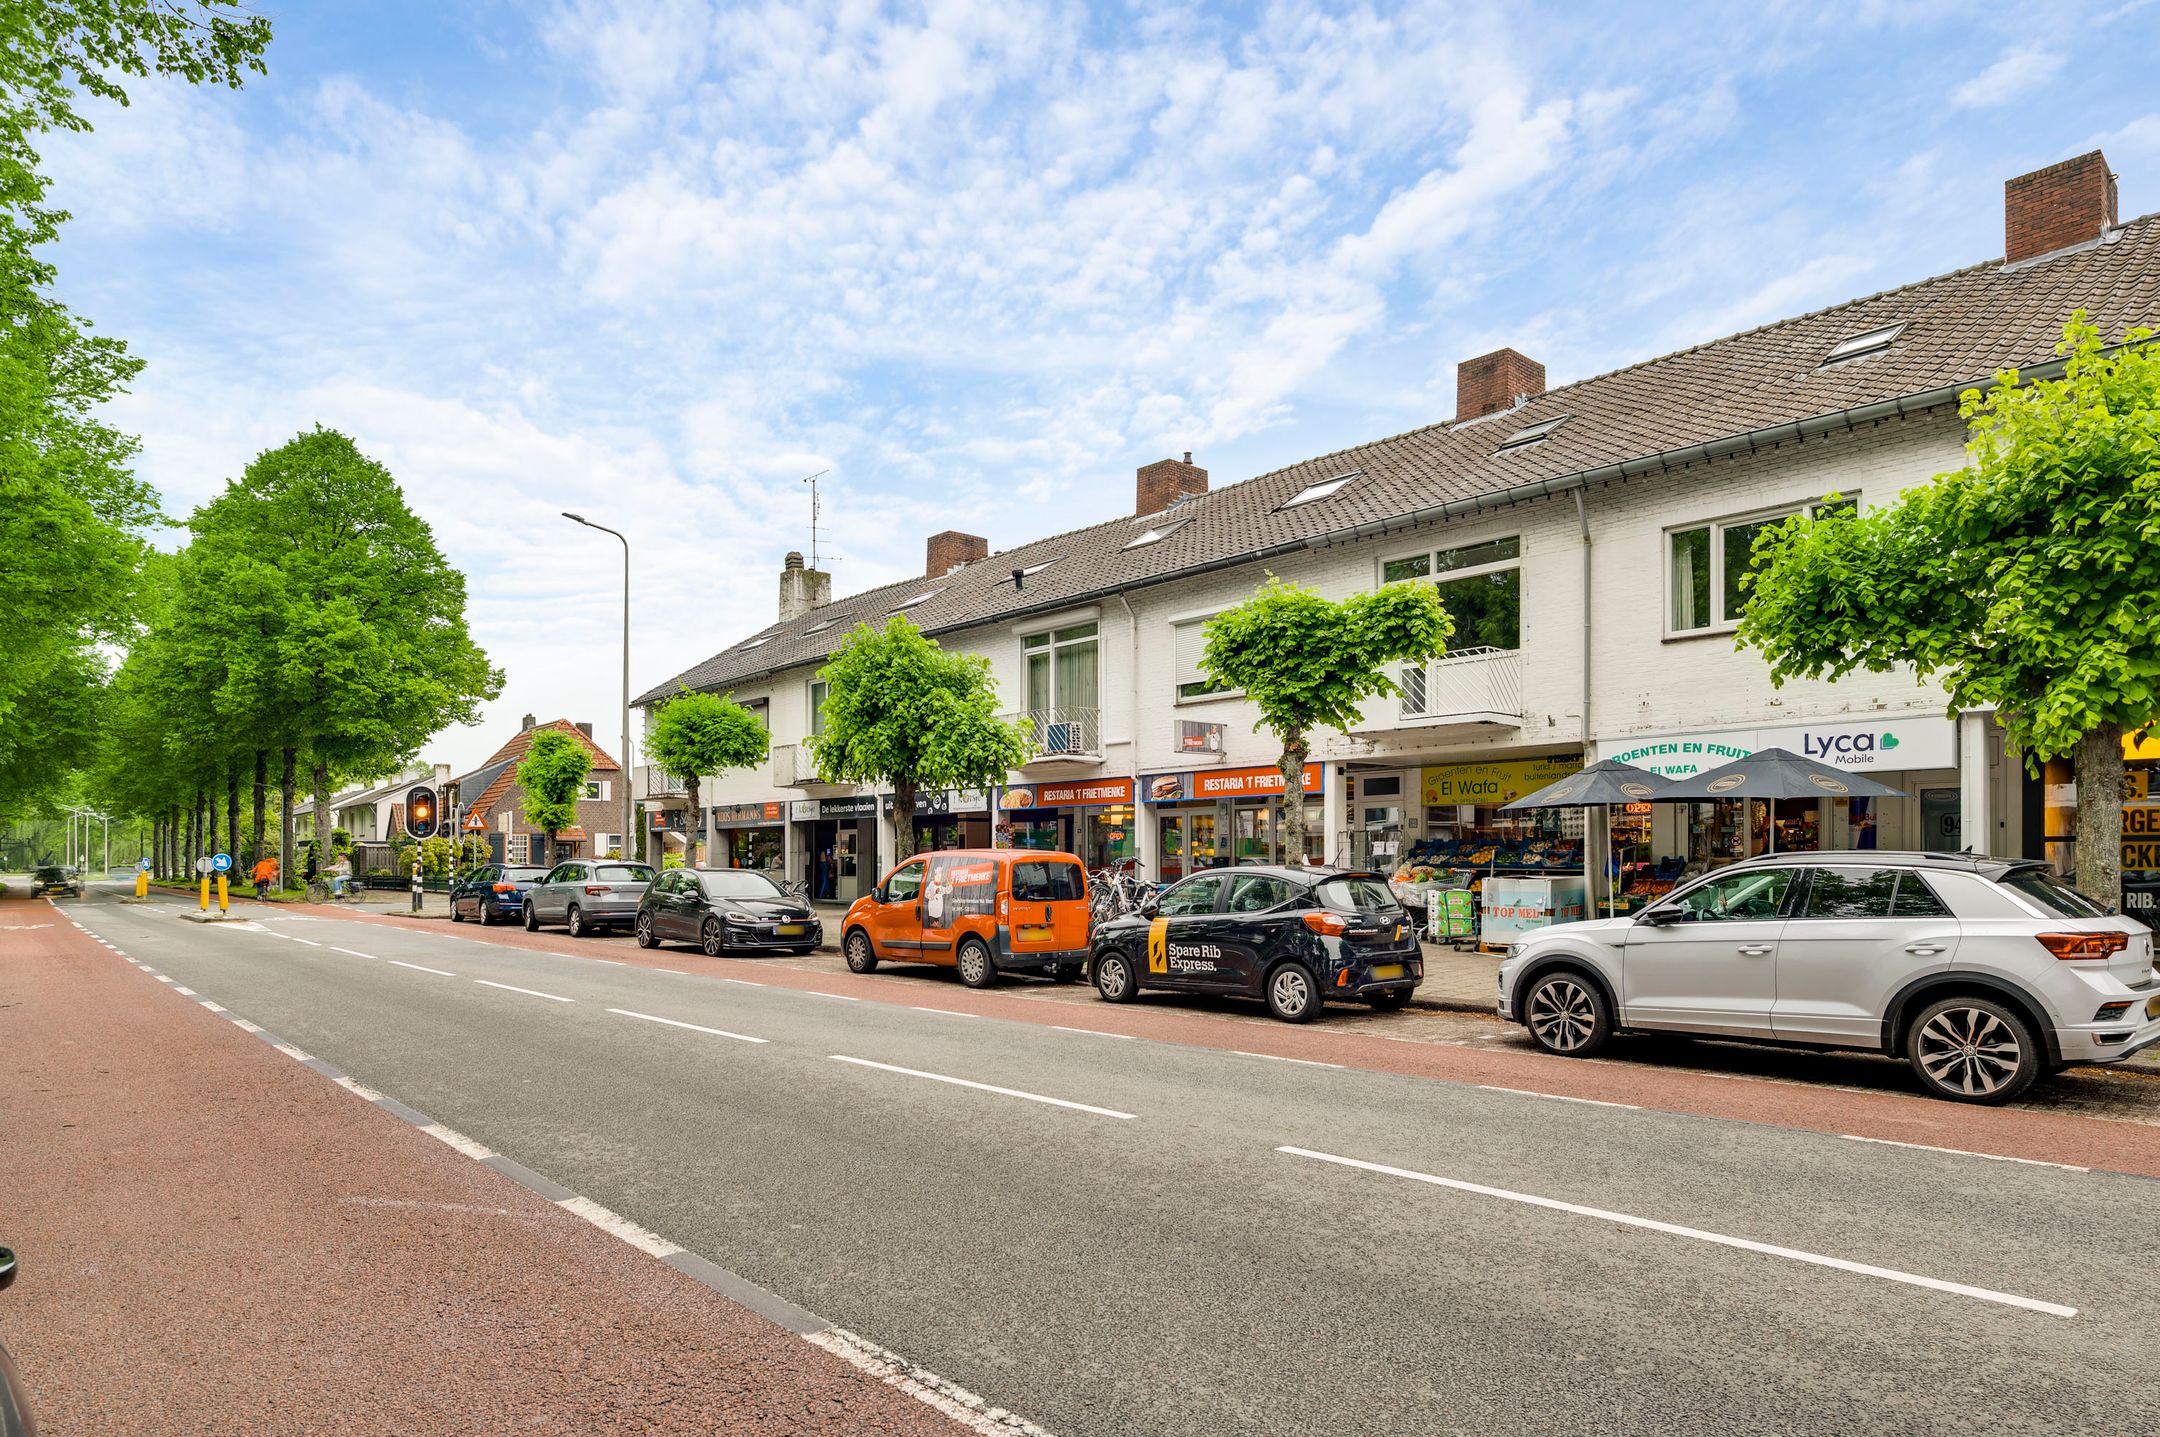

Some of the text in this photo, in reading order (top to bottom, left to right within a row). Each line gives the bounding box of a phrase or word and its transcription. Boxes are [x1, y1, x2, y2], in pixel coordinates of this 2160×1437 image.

[1611, 744, 1678, 763] ROENTEN
[1683, 743, 1702, 753] EN
[1804, 733, 1874, 758] Lyca
[1835, 754, 1874, 764] Mobile
[1428, 766, 1472, 785] Groenten
[1475, 765, 1489, 775] en
[1665, 764, 1698, 774] WAFA
[1204, 777, 1244, 791] RESTARIA
[1458, 779, 1498, 795] Wafa
[1044, 789, 1075, 801] RESTARIA
[1082, 786, 1126, 799] FRIETMENKE
[821, 805, 829, 813] De
[829, 804, 854, 813] lekkerste
[854, 802, 875, 812] vlaaien
[884, 801, 894, 810] uit
[1108, 831, 1125, 841] OPEN
[2126, 892, 2157, 909] RIB.
[1493, 906, 1540, 919] TOP MED
[1169, 943, 1221, 959] Spare Rib
[1169, 956, 1218, 972] Express.
